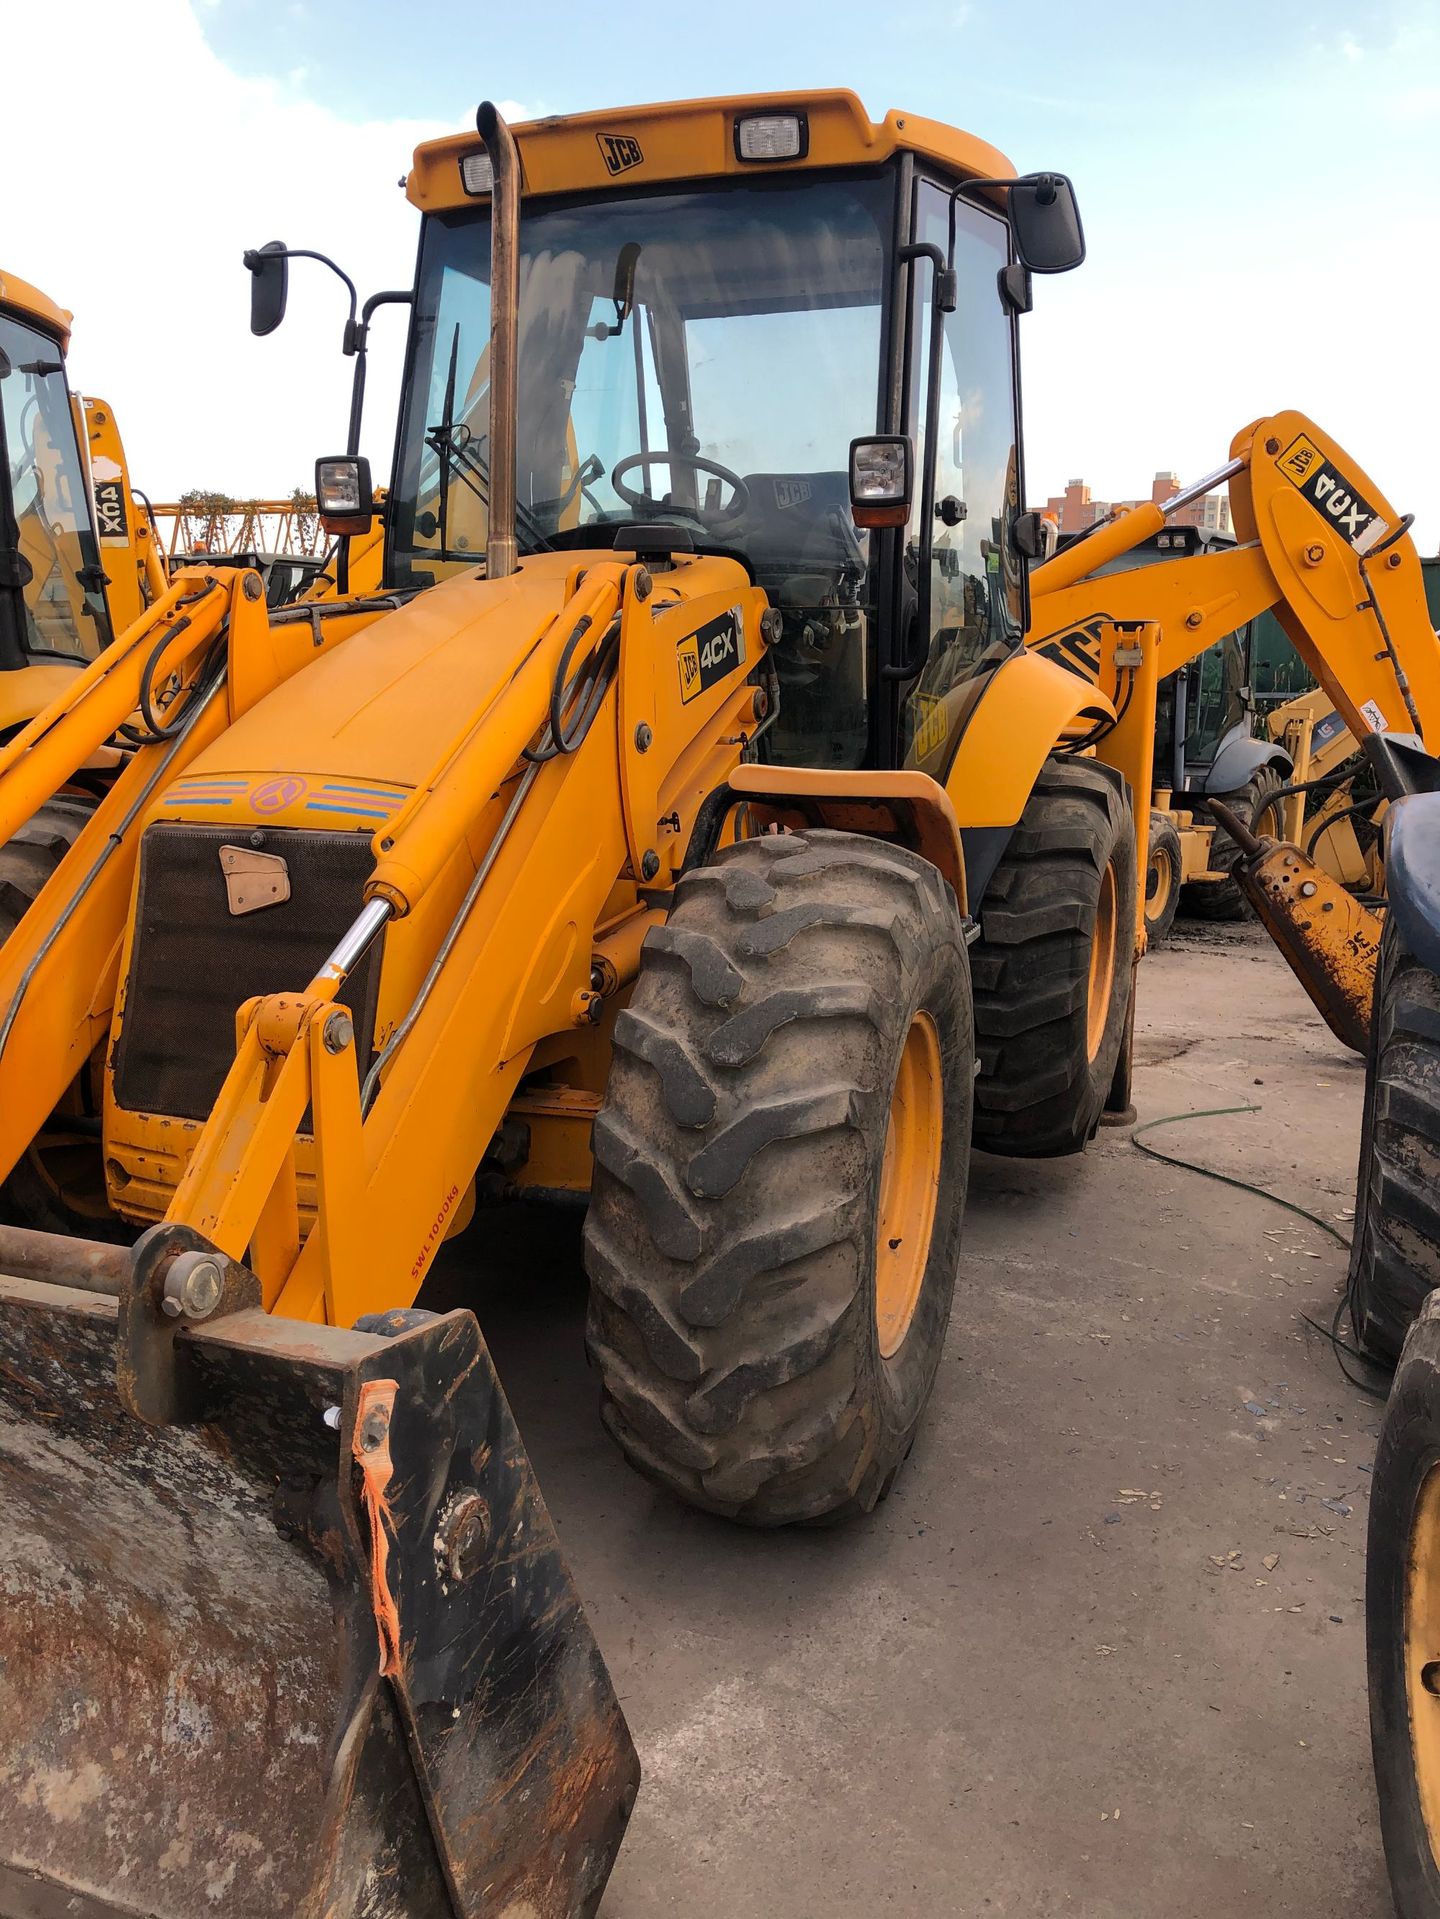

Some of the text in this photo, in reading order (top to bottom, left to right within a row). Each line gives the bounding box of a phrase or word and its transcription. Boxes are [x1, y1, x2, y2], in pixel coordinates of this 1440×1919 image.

[603, 137, 641, 171] JCB
[1287, 449, 1313, 475] JCB
[100, 486, 123, 533] 4CX
[779, 482, 809, 506] JCB
[1314, 472, 1369, 536] 4CX
[683, 627, 735, 685] JCB 4CX
[916, 700, 947, 757] JCB
[411, 1184, 459, 1279] SWL 1000kg
